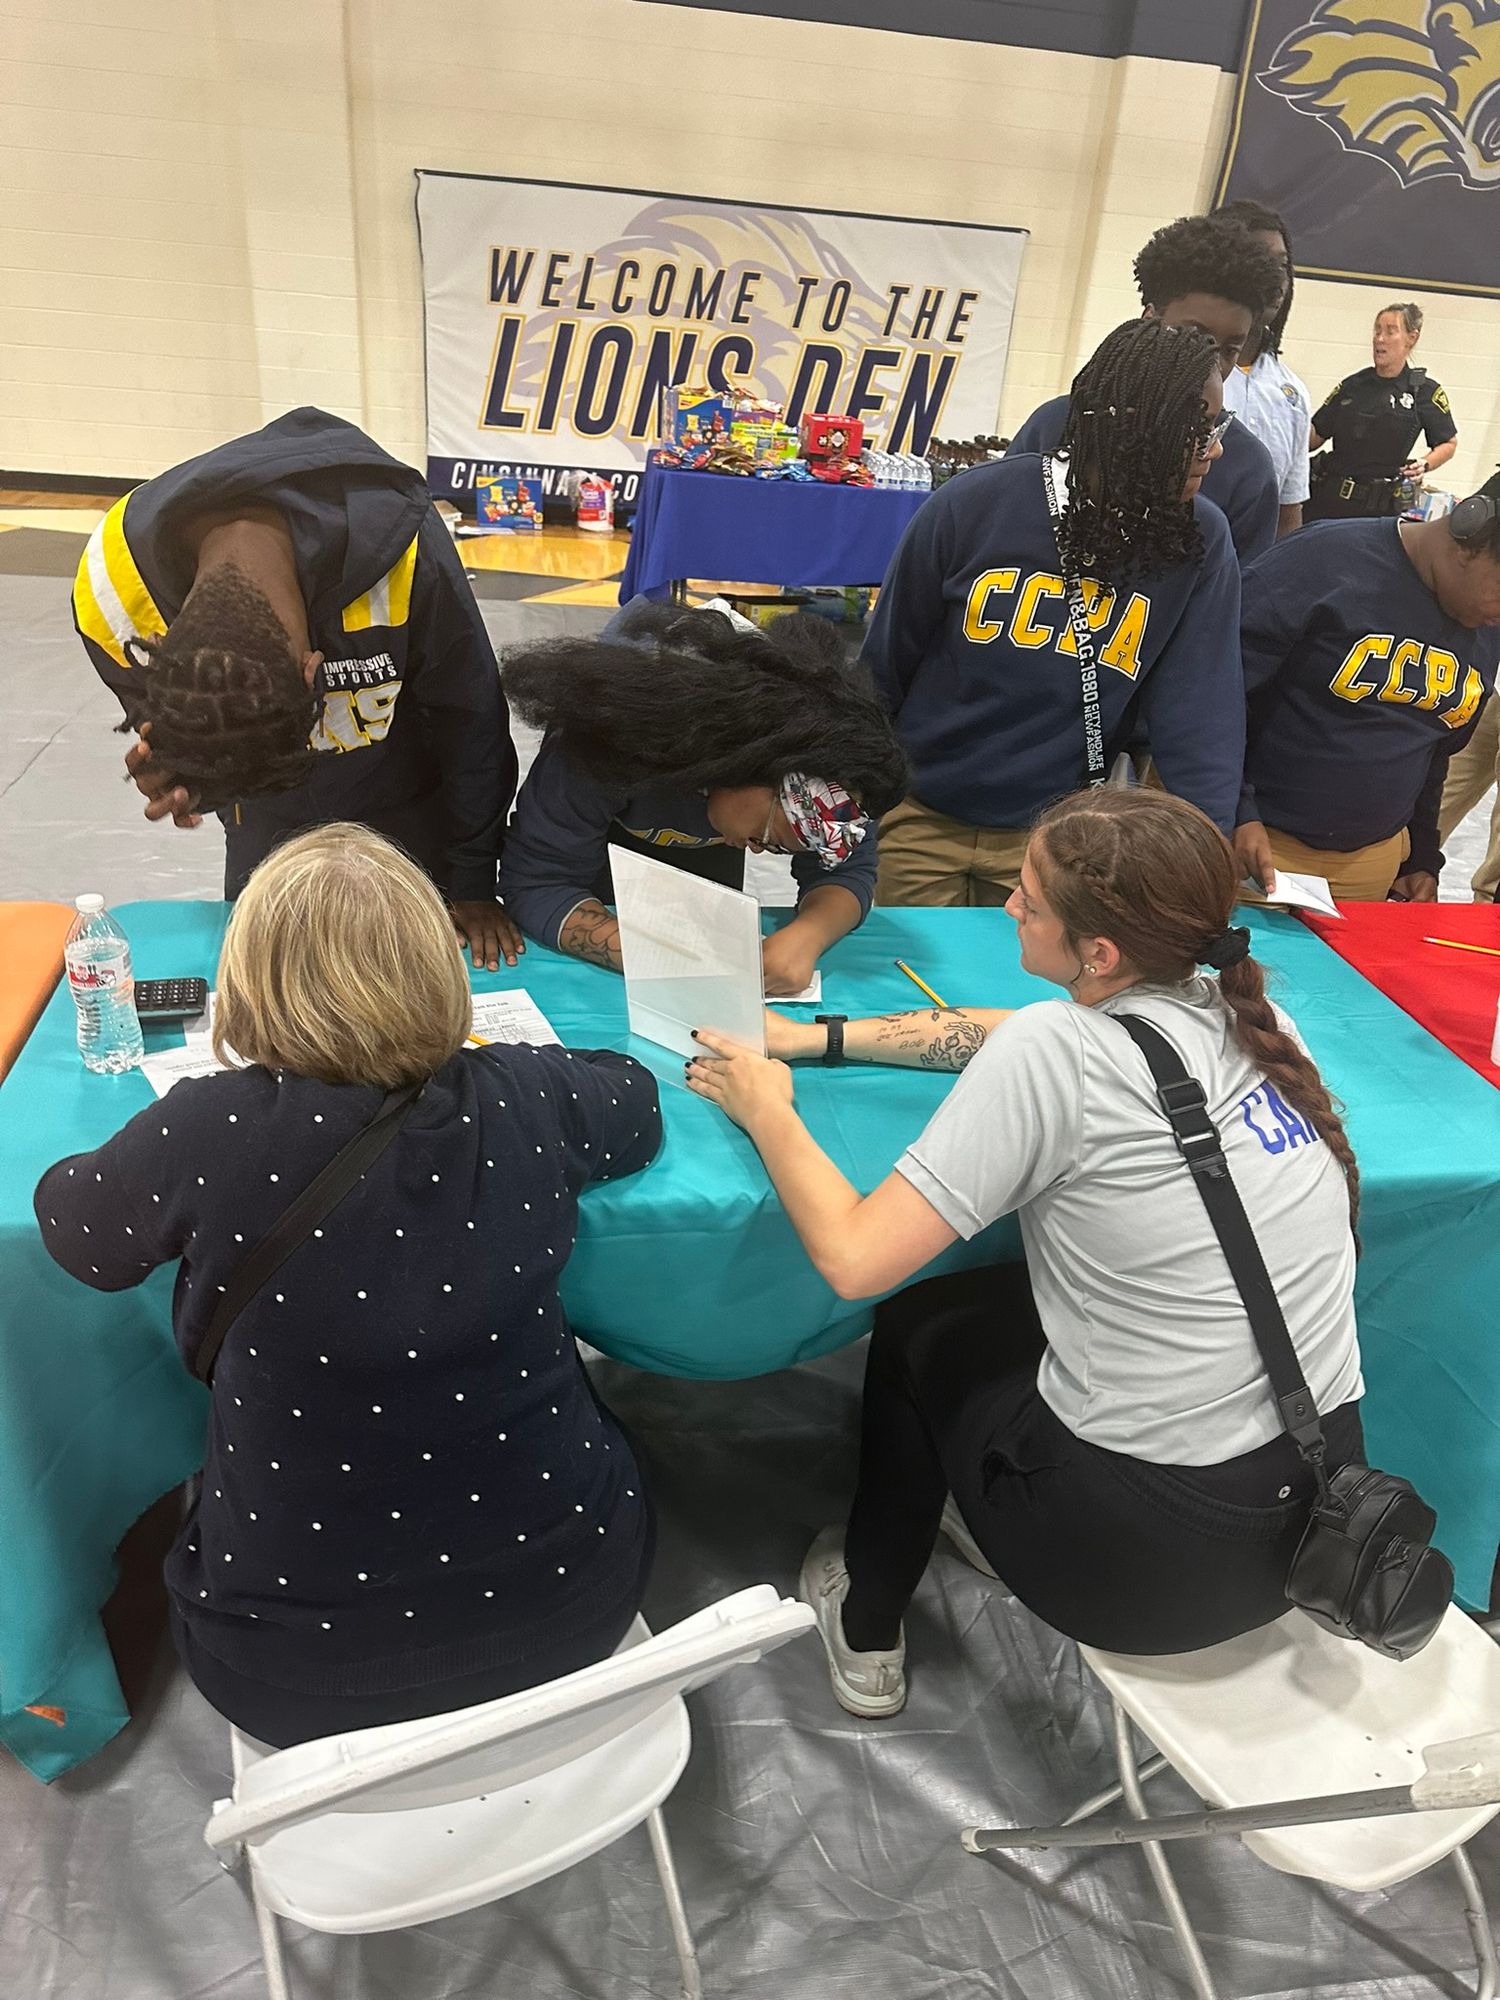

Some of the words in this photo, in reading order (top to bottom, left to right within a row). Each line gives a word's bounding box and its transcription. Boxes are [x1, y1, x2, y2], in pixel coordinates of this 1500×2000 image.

[489, 245, 763, 325] WELCOME
[792, 275, 853, 334] TO
[880, 283, 981, 344] THE
[784, 339, 963, 457] DEN
[1042, 455, 1058, 516] EWFASHION
[963, 567, 1151, 681] CCPA
[323, 653, 393, 675] IMPRESSIVE
[325, 666, 397, 687] SPORTS
[1328, 634, 1485, 729] CCPA
[1084, 705, 1096, 771] NEWFASHION
[1239, 1080, 1318, 1155] CA
